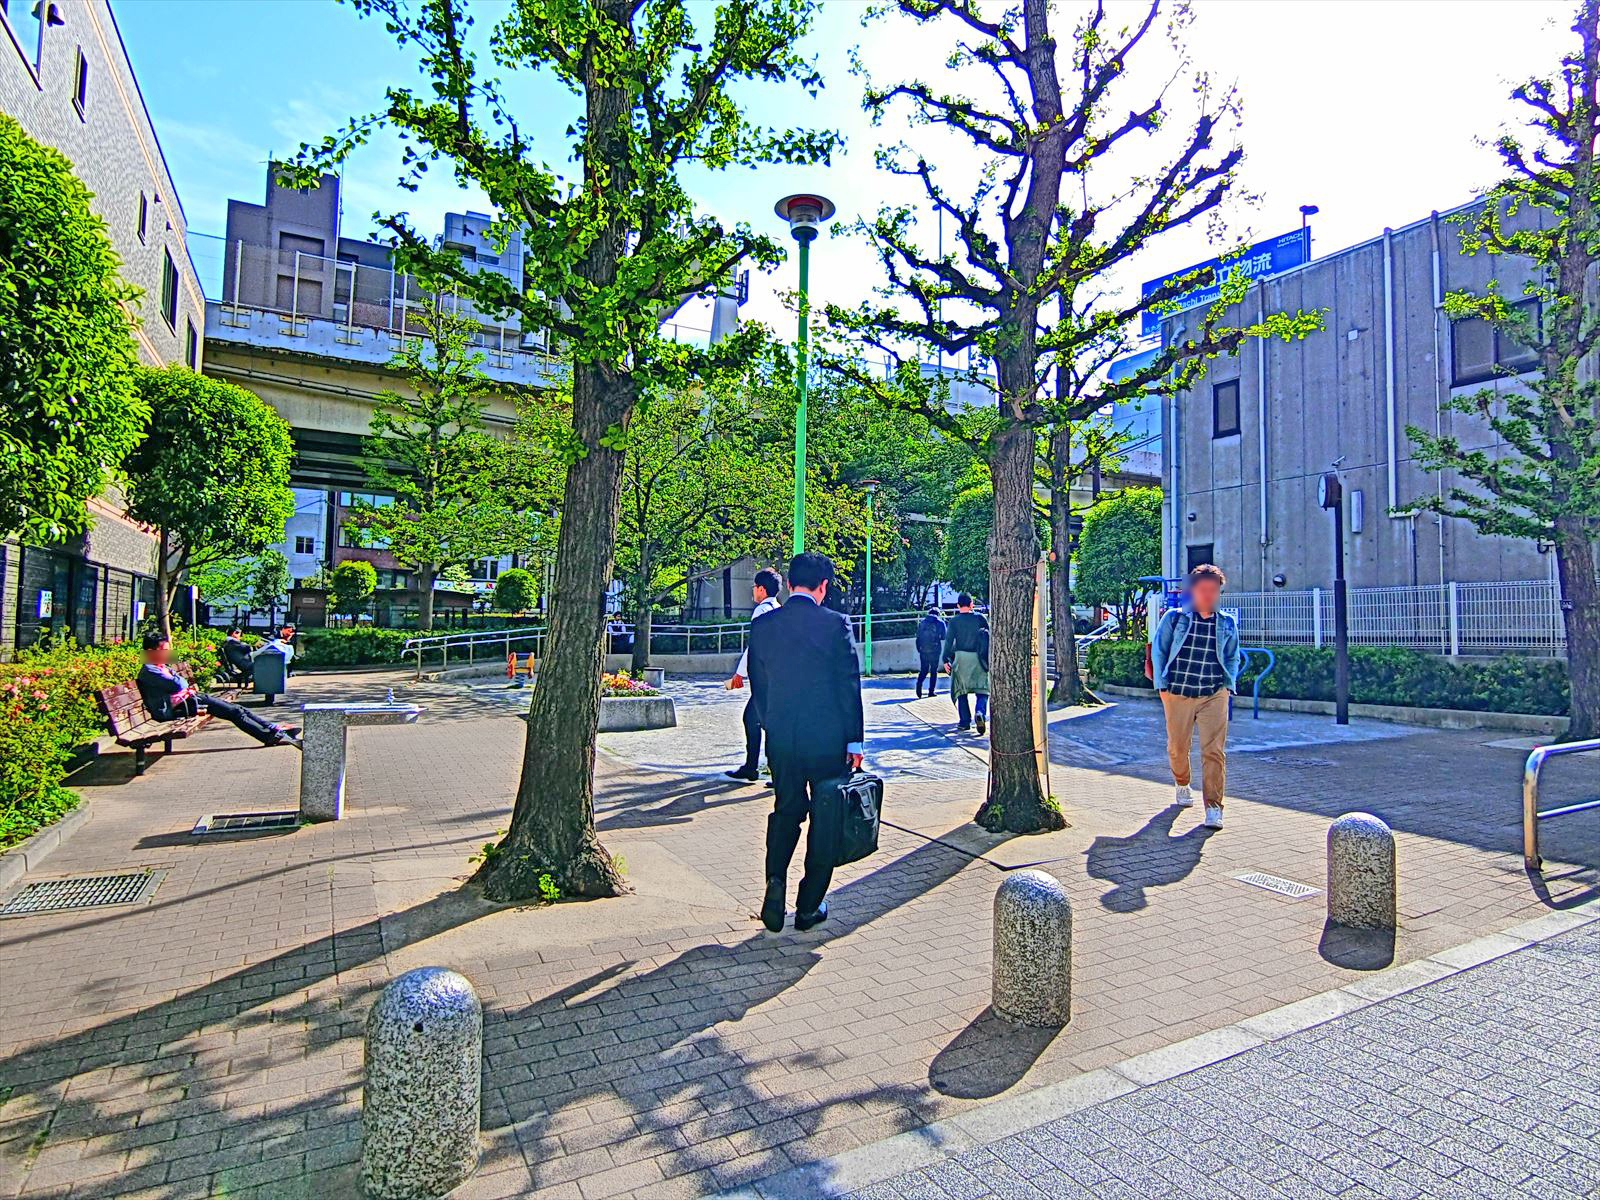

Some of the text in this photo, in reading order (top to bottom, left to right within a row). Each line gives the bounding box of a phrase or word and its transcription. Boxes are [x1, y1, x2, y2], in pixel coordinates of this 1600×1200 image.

[1278, 231, 1304, 244] HITACH
[1203, 252, 1272, 288] 立物流
